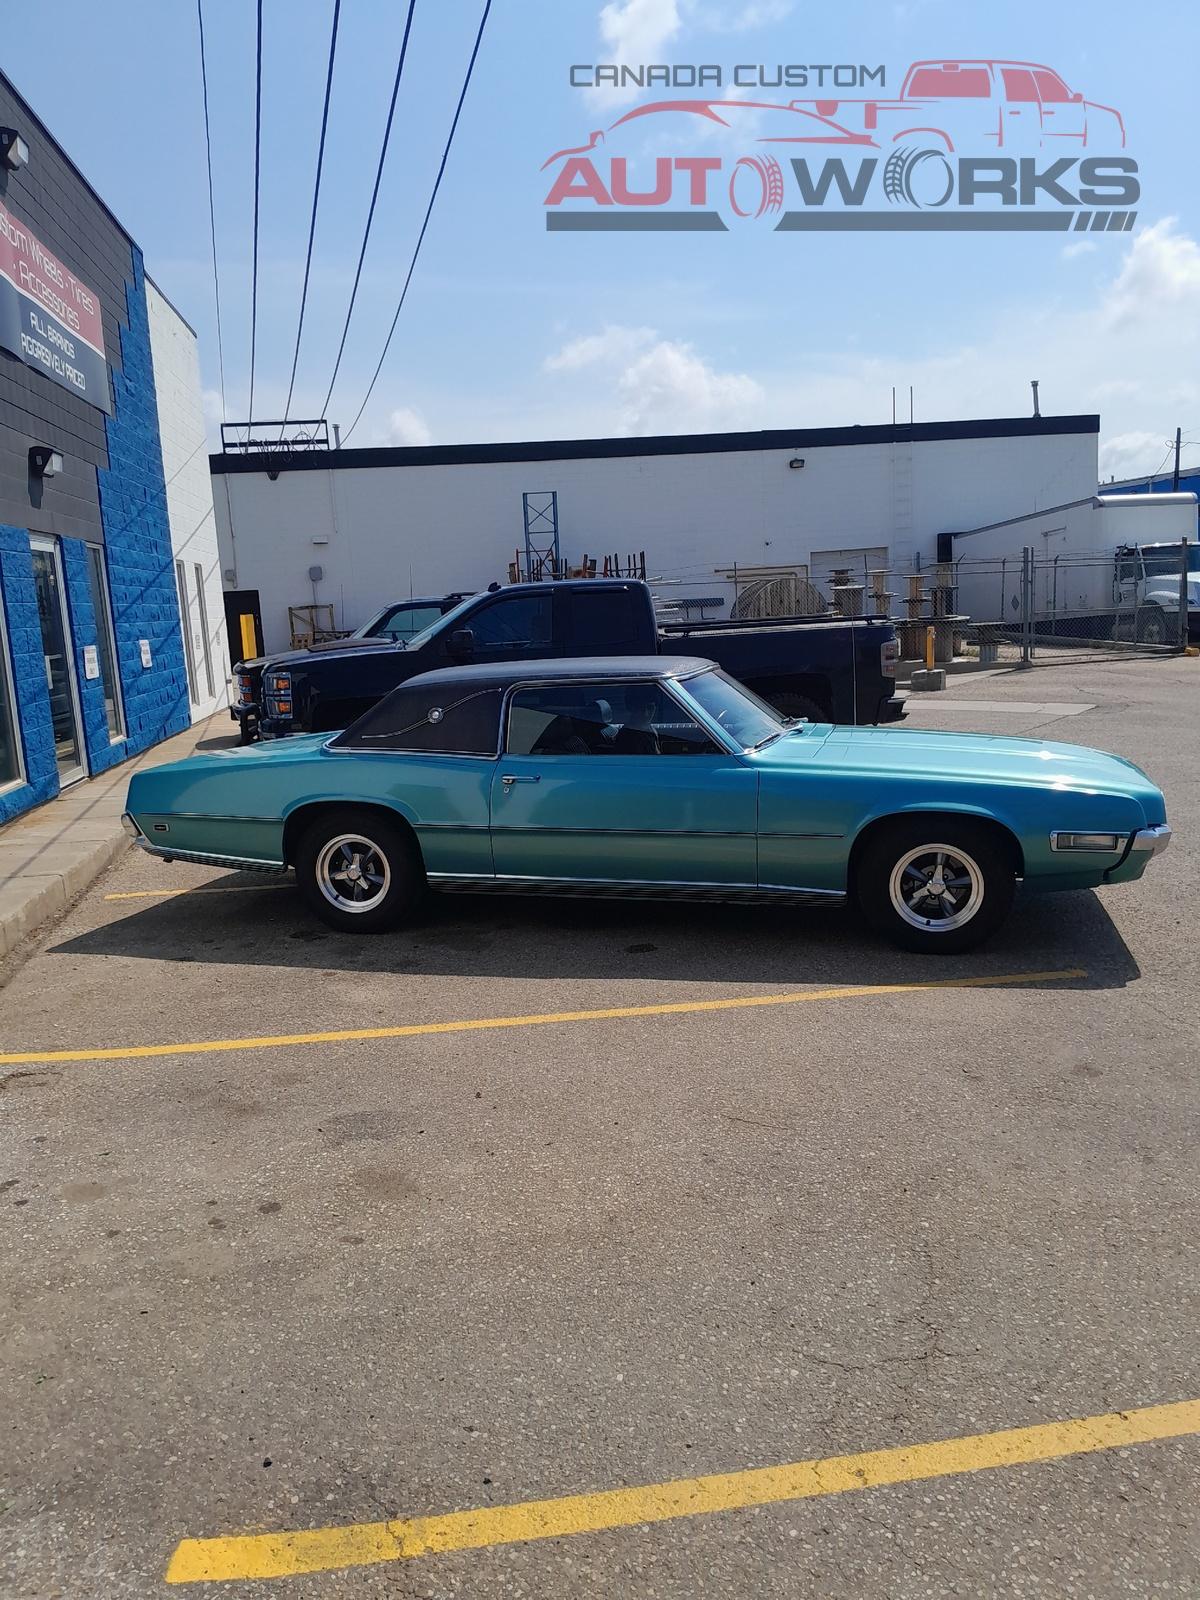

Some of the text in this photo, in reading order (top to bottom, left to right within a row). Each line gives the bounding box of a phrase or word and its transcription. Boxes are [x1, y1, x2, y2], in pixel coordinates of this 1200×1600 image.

[19, 260, 80, 330] Accessories
[28, 236, 64, 289] Wheels
[67, 275, 94, 315] Tires
[30, 311, 76, 360] ALL BRANDS
[65, 362, 86, 391] PRICED
